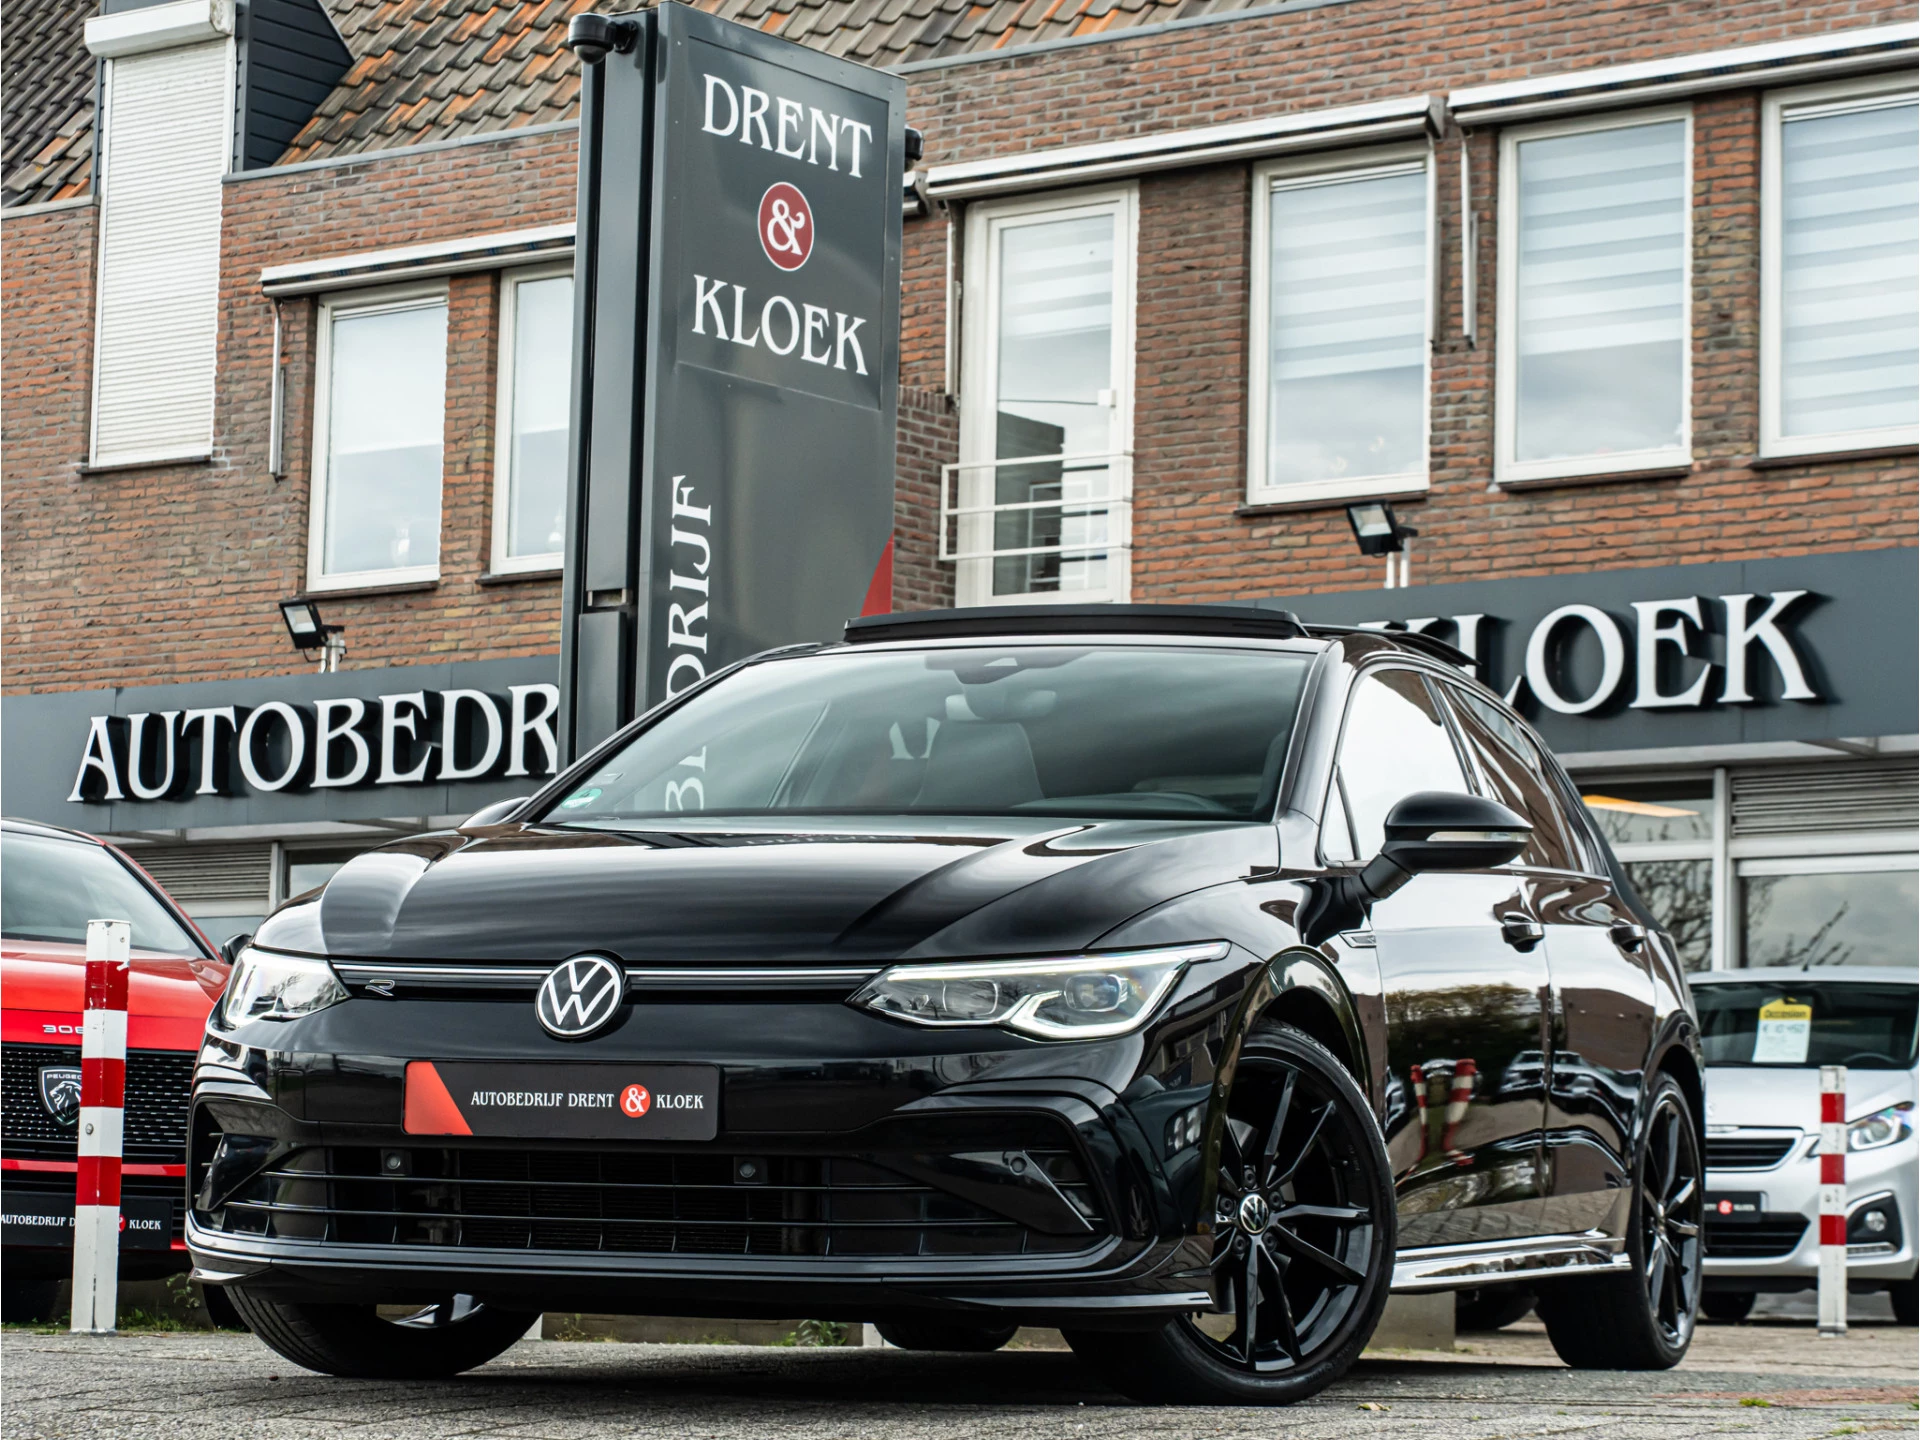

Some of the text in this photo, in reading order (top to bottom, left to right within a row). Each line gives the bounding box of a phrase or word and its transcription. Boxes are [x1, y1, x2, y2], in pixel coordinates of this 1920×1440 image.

[701, 73, 873, 178] DRENT
[766, 198, 806, 256] &
[692, 274, 868, 376] KLOEK
[1358, 590, 1816, 714] LOEK
[67, 683, 559, 802] AUTOBEDR
[471, 1087, 704, 1112] AUTOBEDRIJF DRENT & KLOEK
[129, 1219, 161, 1230] KLOEK
